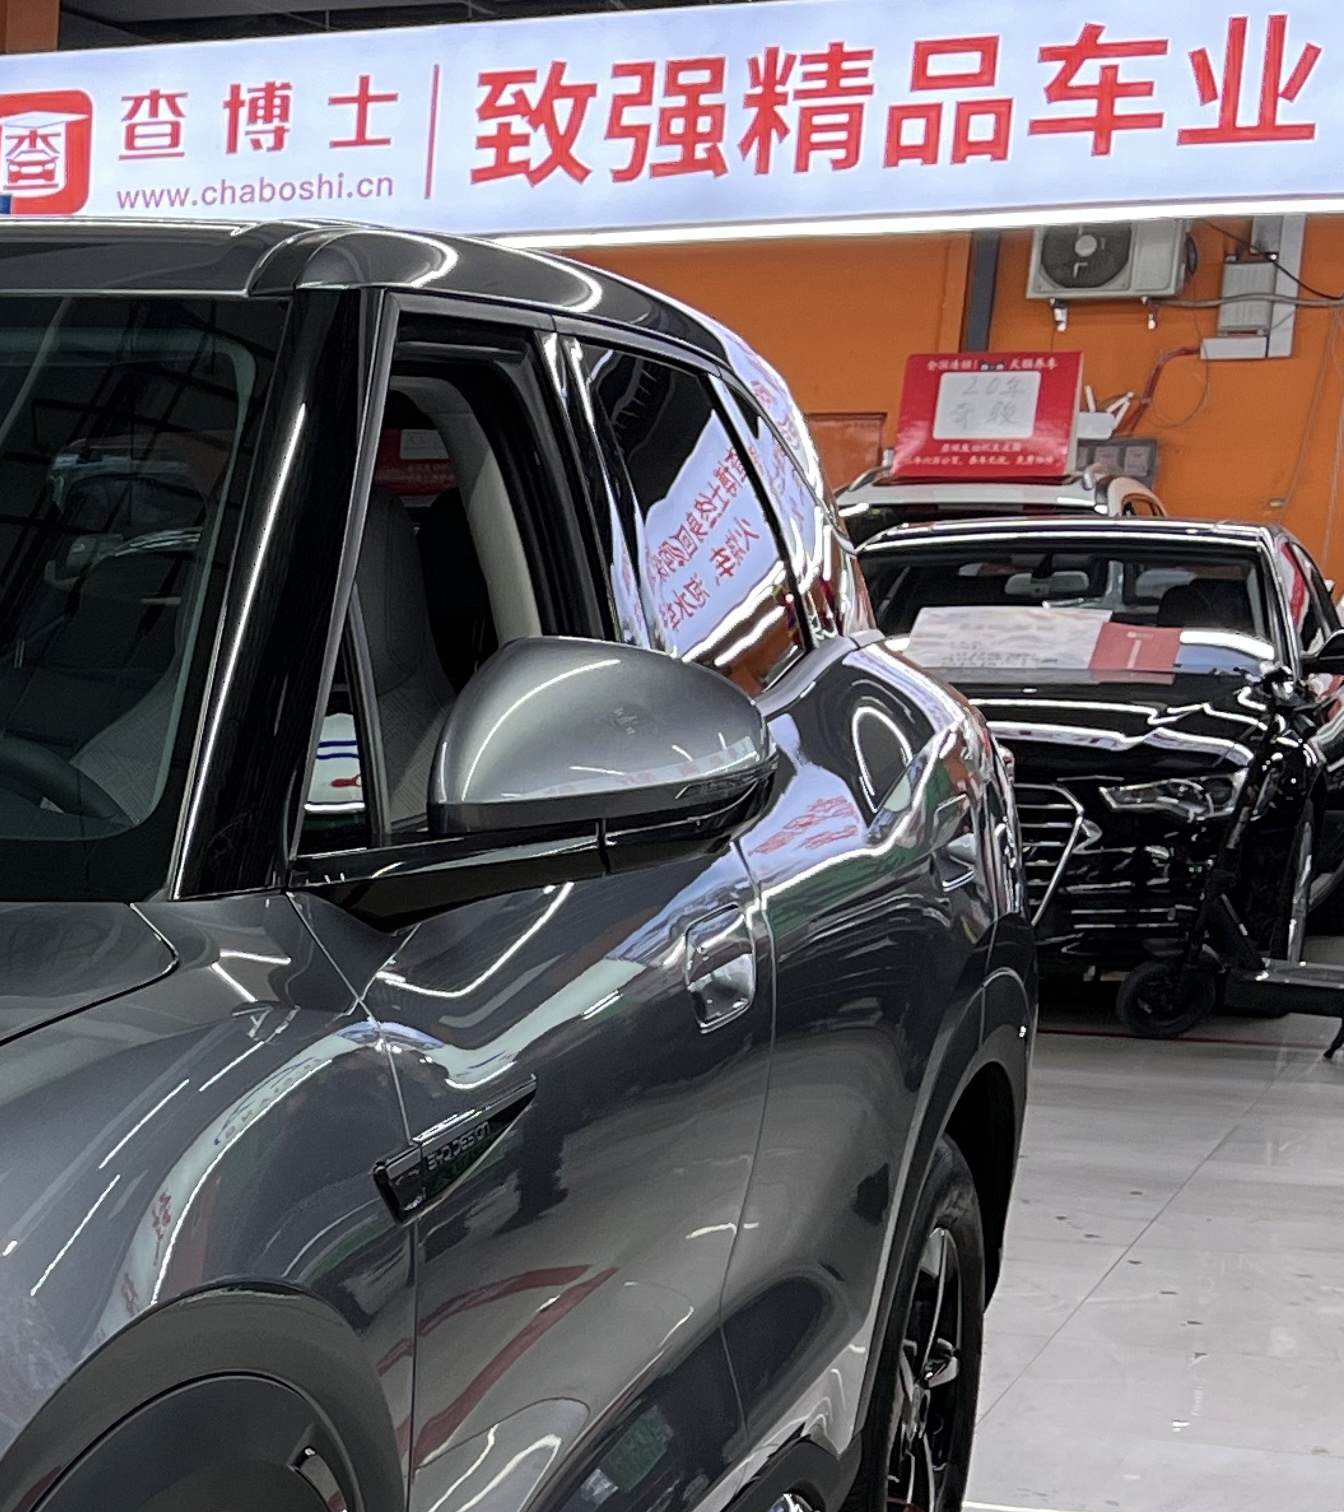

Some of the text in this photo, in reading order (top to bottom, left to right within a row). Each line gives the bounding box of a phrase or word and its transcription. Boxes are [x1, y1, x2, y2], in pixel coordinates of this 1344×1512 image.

[119, 74, 399, 161] 查博士
[470, 14, 1323, 188] 致强精品车业
[116, 172, 395, 210] www.chaboshi.cn
